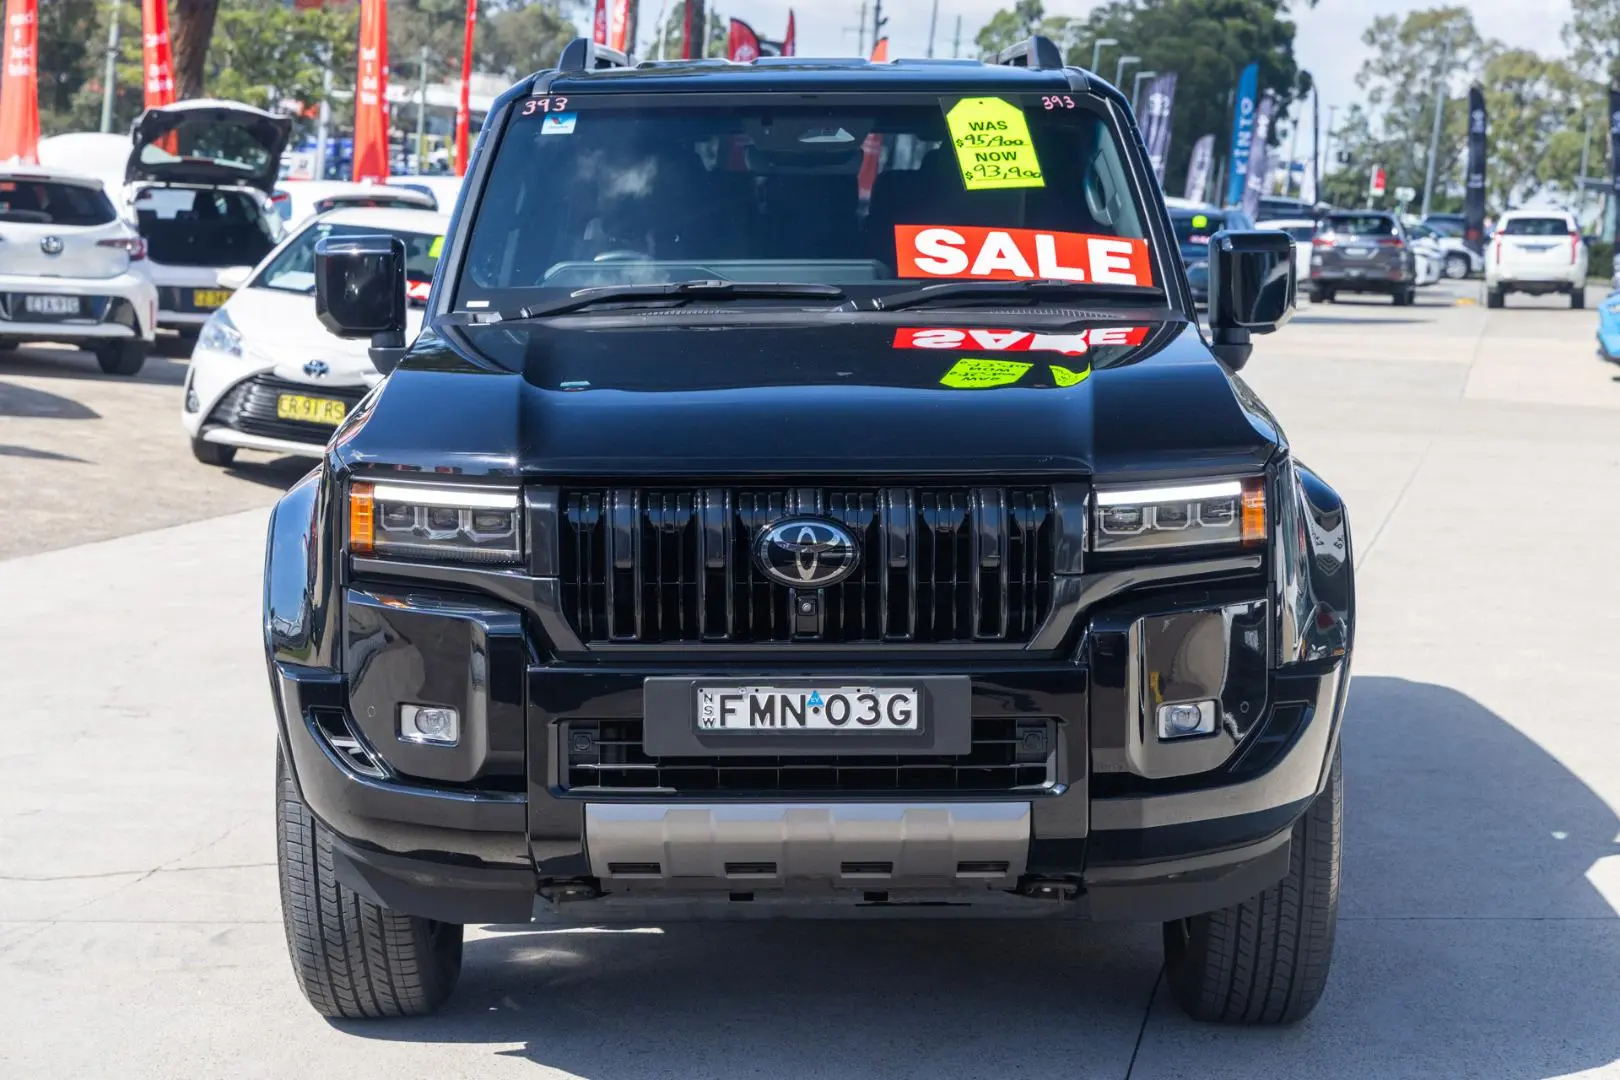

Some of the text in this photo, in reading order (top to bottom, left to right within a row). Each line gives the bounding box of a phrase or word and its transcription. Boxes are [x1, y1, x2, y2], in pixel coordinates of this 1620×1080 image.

[522, 97, 568, 115] 393
[1042, 96, 1075, 110] 393
[968, 121, 1008, 131] WAS
[975, 152, 1017, 162] NOW
[914, 229, 1137, 286] SALE
[702, 693, 715, 727] NSW
